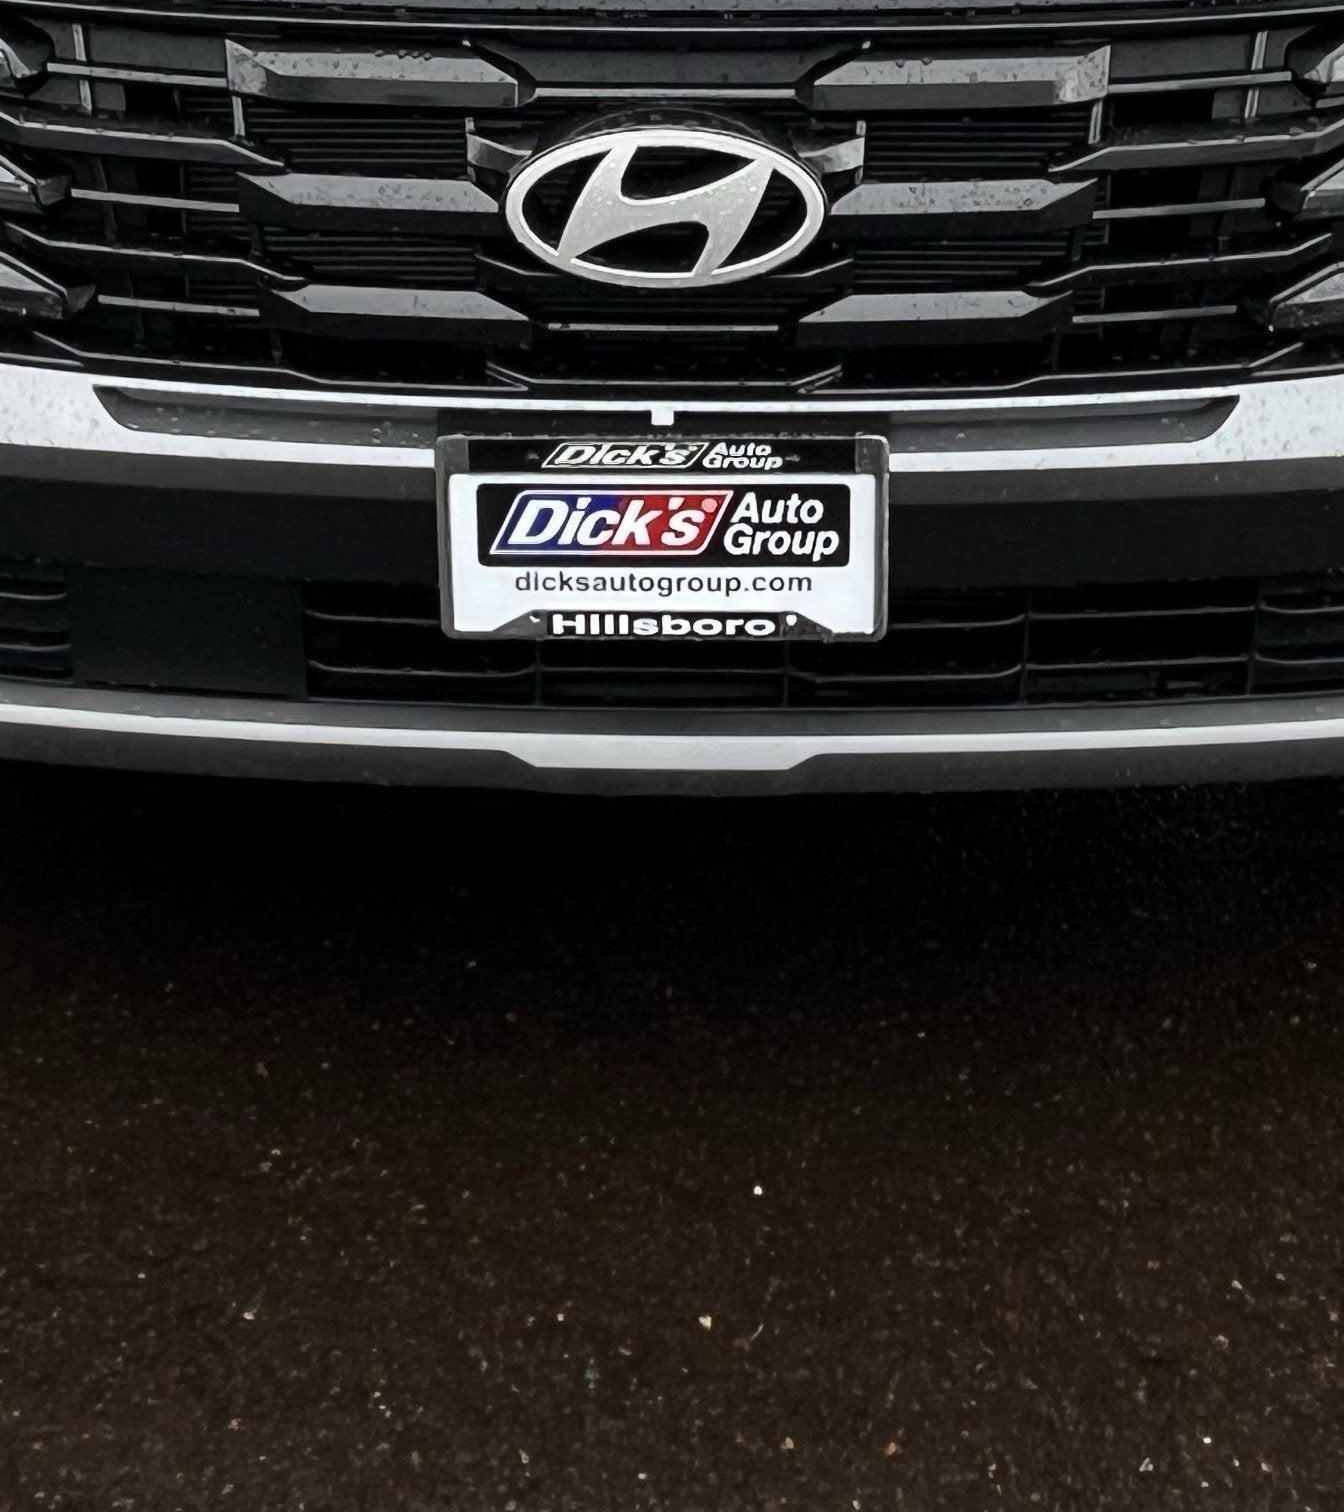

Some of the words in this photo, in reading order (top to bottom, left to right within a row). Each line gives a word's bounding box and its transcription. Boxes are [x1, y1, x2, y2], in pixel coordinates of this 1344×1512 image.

[554, 443, 692, 465] Dick's
[708, 442, 772, 457] Auto
[702, 454, 783, 470] Group
[508, 496, 706, 546] Dick's
[730, 491, 824, 524] Auto
[723, 523, 840, 562] Group
[515, 571, 813, 597] dicksautogroup.com
[552, 614, 777, 636] Hillsboro
